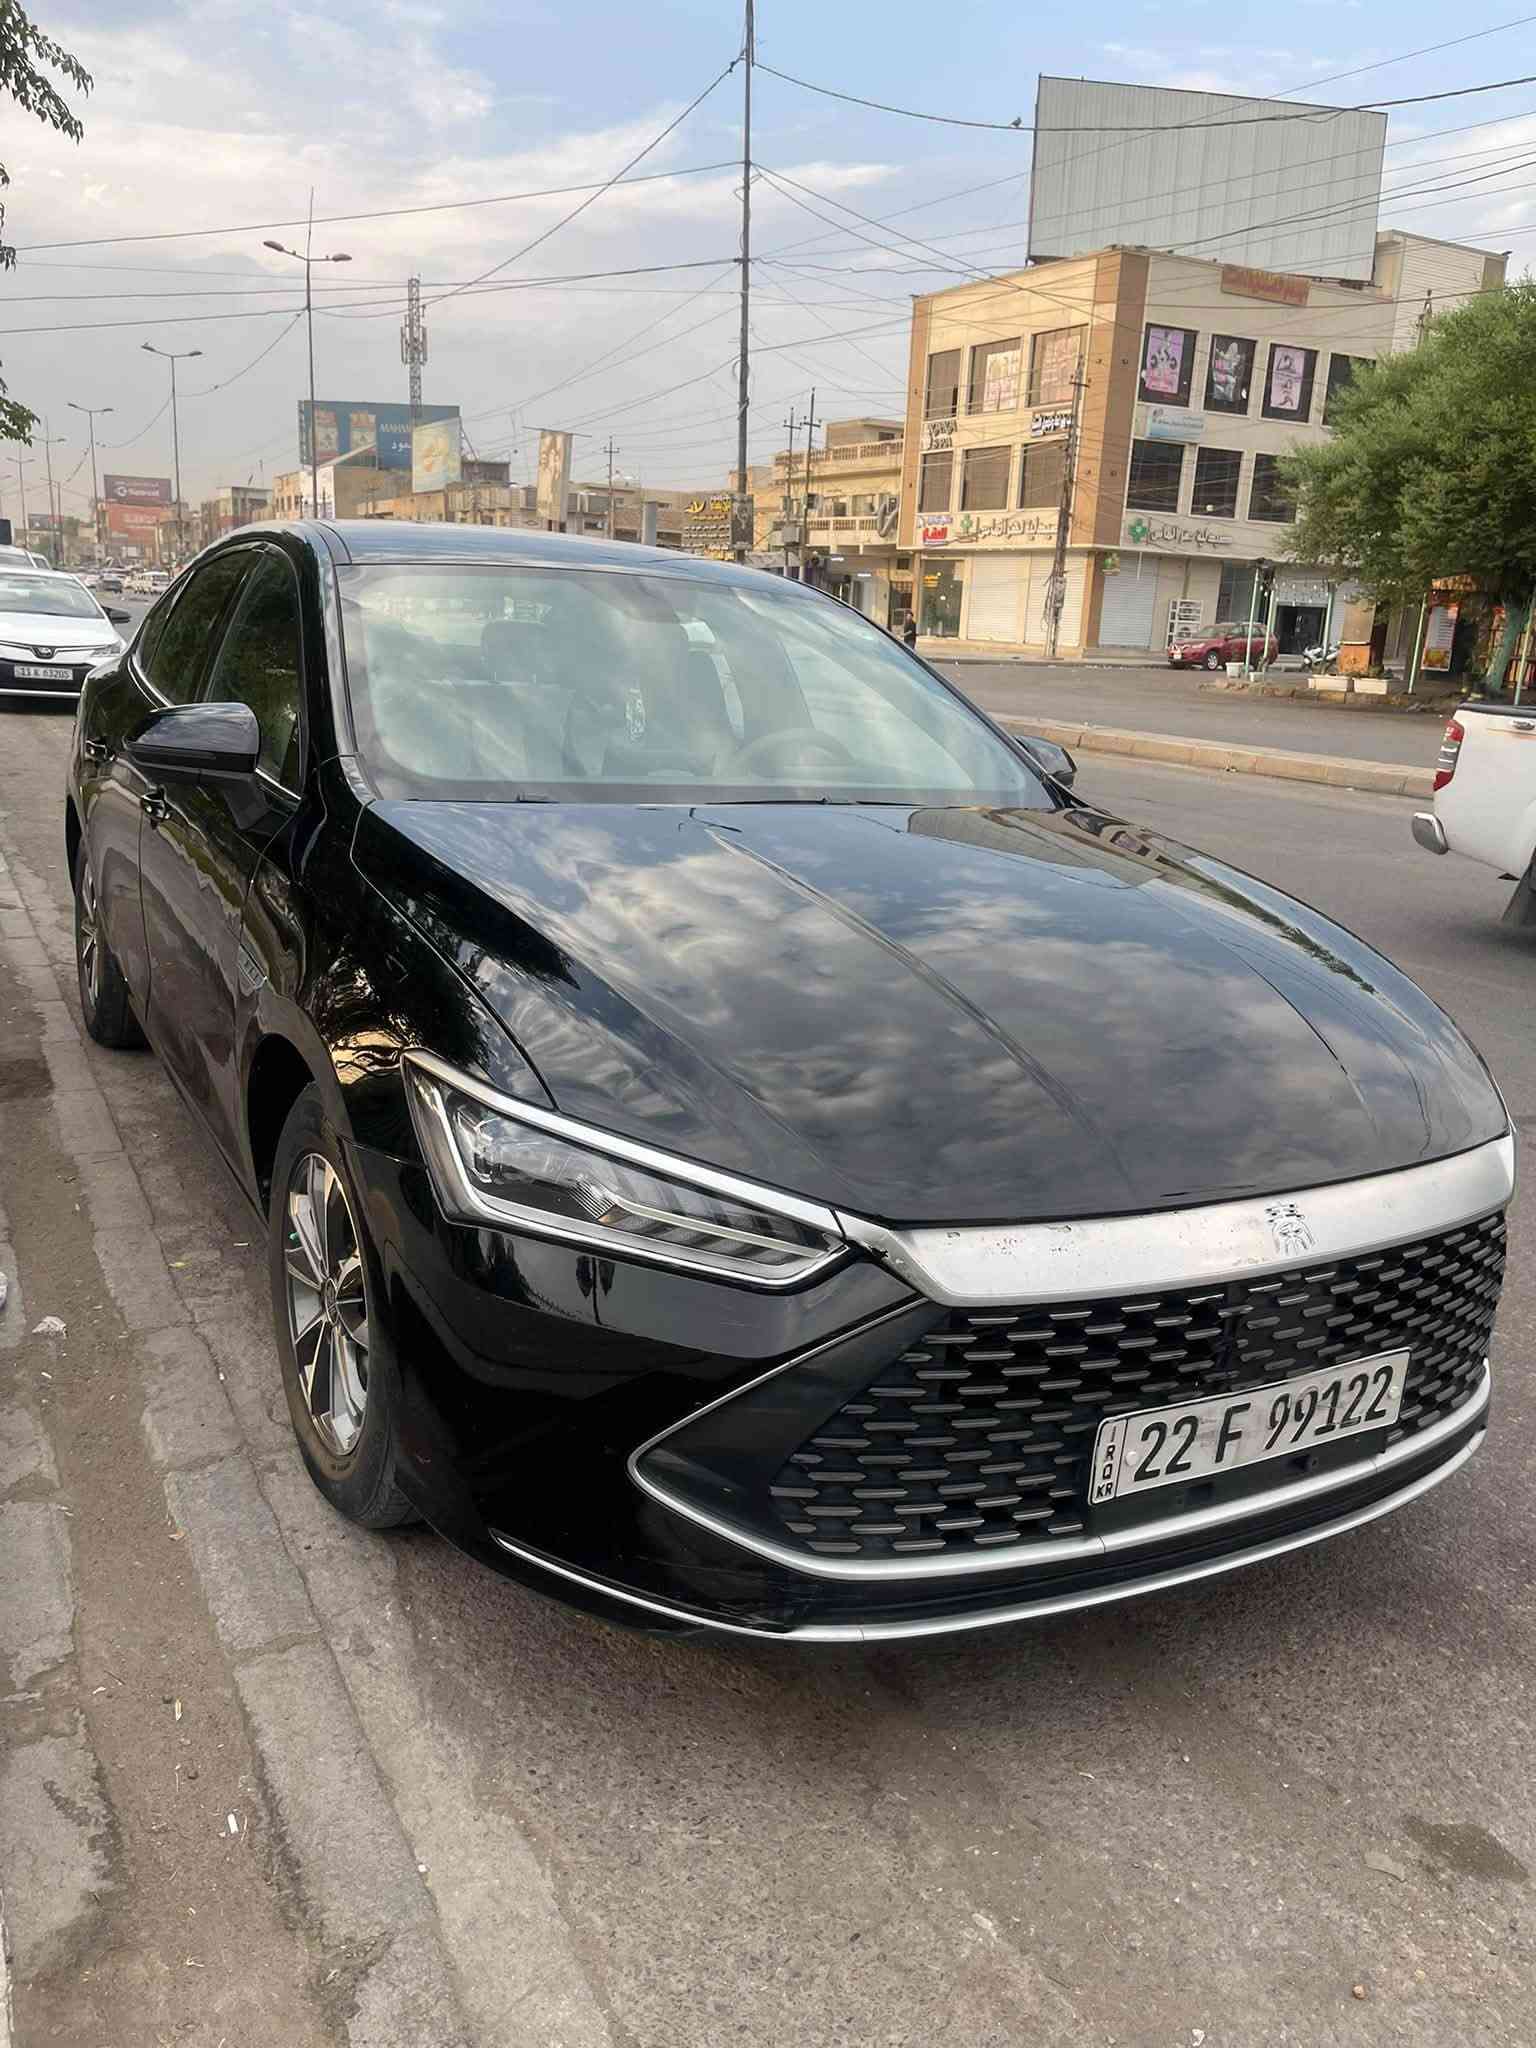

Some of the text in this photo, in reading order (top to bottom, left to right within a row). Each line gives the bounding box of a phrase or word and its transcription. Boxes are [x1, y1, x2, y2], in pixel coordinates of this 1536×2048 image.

[1133, 1364, 1395, 1483] 22 F 99122
[1095, 1482, 1114, 1499] KR
